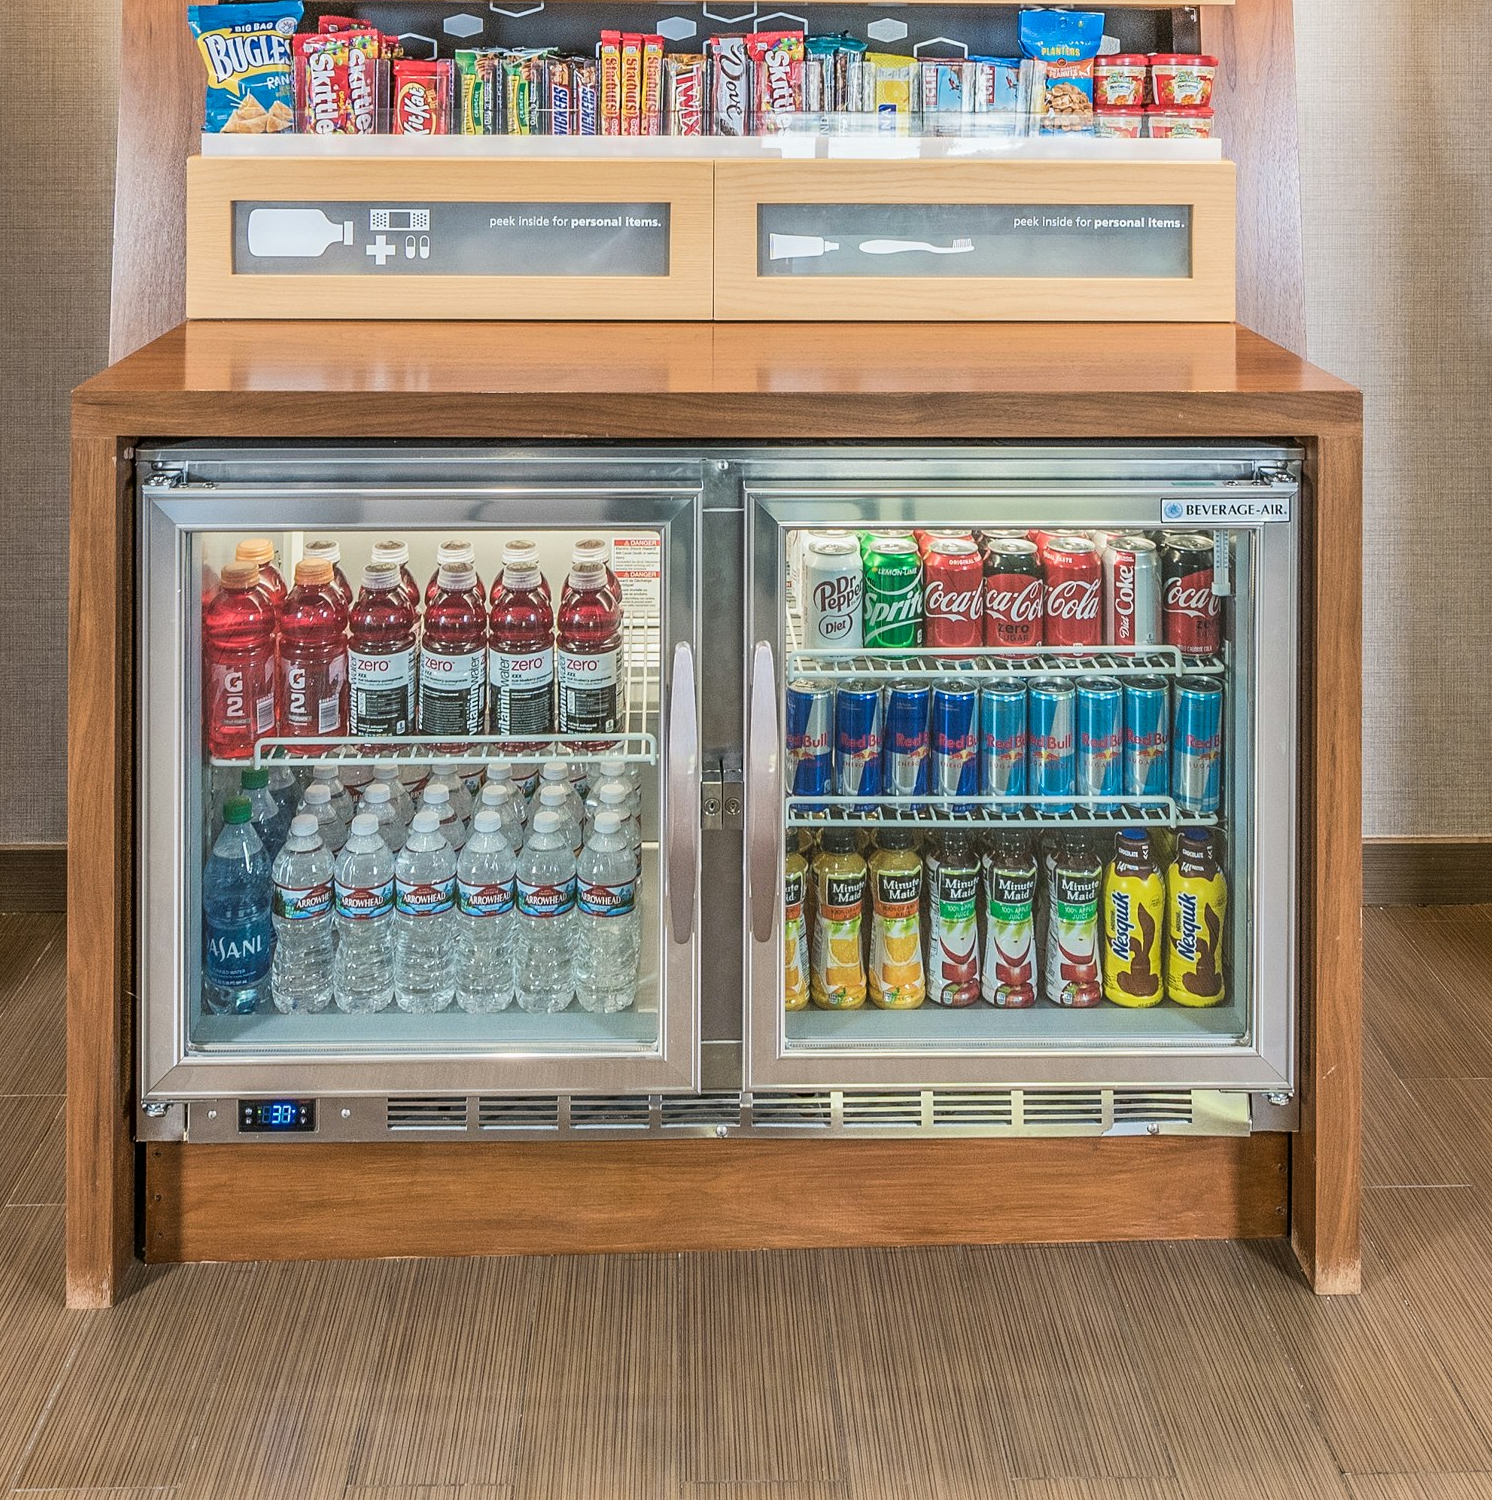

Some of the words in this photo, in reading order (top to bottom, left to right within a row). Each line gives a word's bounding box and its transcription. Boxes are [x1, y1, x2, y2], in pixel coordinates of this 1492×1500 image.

[253, 23, 273, 31] BAG
[1042, 47, 1080, 56] PLANTERS
[719, 43, 743, 121] Dove
[309, 53, 335, 135] Skittle
[348, 49, 371, 134] Skittle
[676, 64, 703, 135] TWIX
[489, 216, 515, 228] peek
[518, 216, 549, 226] inside
[552, 216, 568, 226] for
[571, 216, 622, 229] personal
[626, 217, 662, 227] items.
[1013, 216, 1039, 228] peek
[1043, 217, 1072, 227] inside
[1075, 216, 1092, 227] for
[1094, 217, 1144, 229] personal
[1148, 218, 1185, 228] items.
[836, 574, 856, 594] Dr
[1115, 565, 1134, 615] Coke
[813, 579, 863, 613] Pepper
[825, 620, 846, 635] Diet
[1119, 616, 1130, 639] Diet
[358, 660, 388, 671] zero
[426, 657, 452, 672] zero
[511, 658, 543, 671] zero
[566, 658, 598, 672] zero
[226, 694, 244, 716] 2
[291, 691, 306, 714] 2
[803, 732, 828, 748] Bull
[841, 733, 866, 748] Red
[896, 733, 921, 747] Red
[939, 733, 964, 749] Red
[987, 733, 1013, 749] Red
[1047, 734, 1071, 749] Bull
[1082, 733, 1108, 749] Red
[1127, 729, 1151, 745] Red
[1186, 734, 1211, 749] Red
[1119, 847, 1138, 857] CHOCOLATE
[1182, 849, 1204, 858] CHOCOLATE
[833, 881, 865, 893] Minute
[883, 878, 919, 890] Minute
[945, 877, 979, 889] Minute
[999, 879, 1033, 890] Minute
[1062, 879, 1099, 891] Minute
[403, 891, 446, 905] ARROWHEAD
[469, 891, 511, 905] ARROWHEAD
[525, 892, 567, 905] ARROWHEAD
[581, 893, 622, 905] ARROWHEAD
[838, 892, 861, 902] Maid
[890, 887, 915, 899] Maid
[950, 887, 976, 899] Maid
[1004, 890, 1029, 900] Maid
[1067, 889, 1095, 901] Maid
[341, 896, 384, 908] ARROWHEAD
[1112, 891, 1135, 960] Nesquik
[1177, 892, 1202, 961] Nesquik
[208, 935, 262, 962] ASANI
